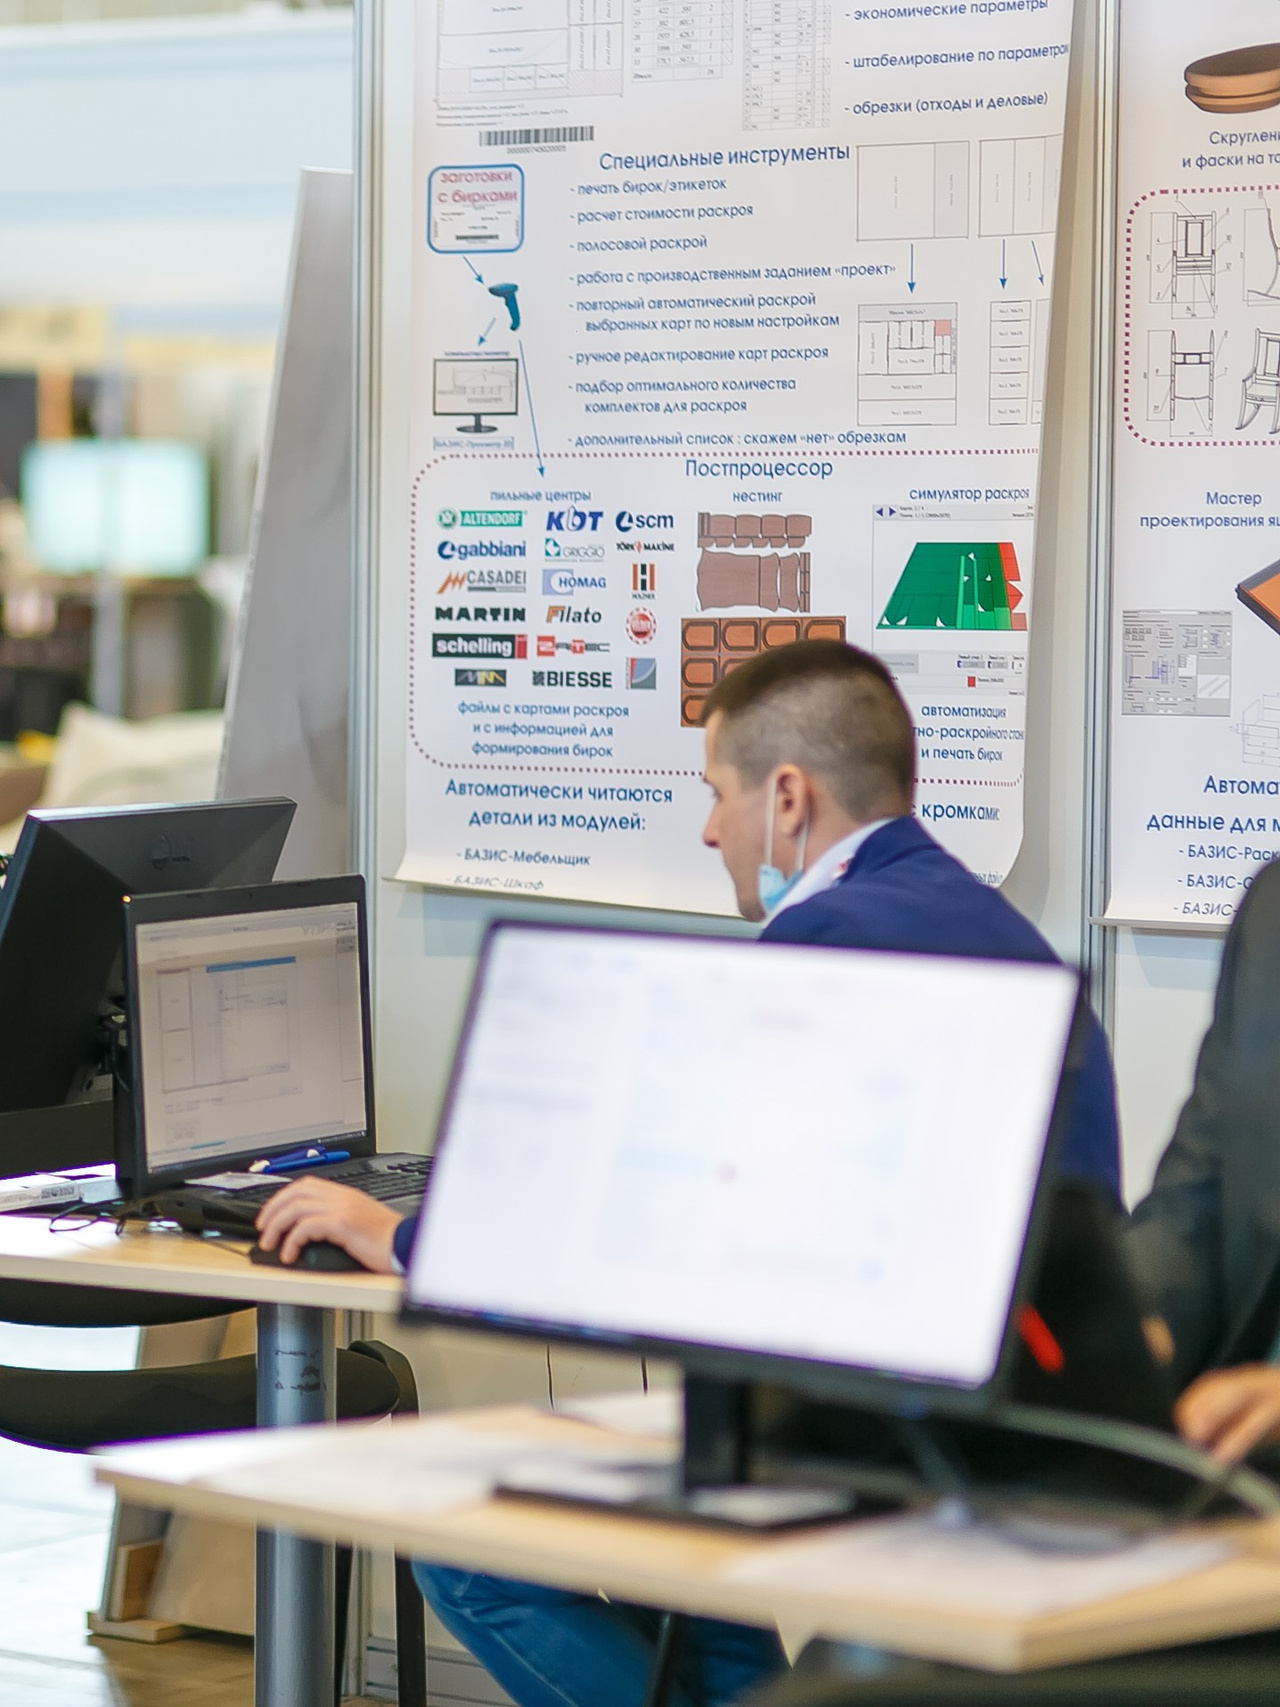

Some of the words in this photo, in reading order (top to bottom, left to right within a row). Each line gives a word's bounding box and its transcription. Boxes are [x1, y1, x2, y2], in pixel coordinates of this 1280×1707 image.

[853, 4, 967, 21] экономические
[853, 50, 975, 69] штабелирование
[978, 51, 995, 63] по
[853, 100, 912, 116] обрезки
[916, 97, 972, 113] (отходы
[975, 97, 984, 109] и
[987, 92, 1049, 111] деловые)
[599, 150, 724, 173] Специальные
[728, 145, 851, 171] инструменты
[1182, 157, 1192, 168] и
[1195, 154, 1244, 171] фаски
[1247, 155, 1264, 165] на
[440, 171, 513, 184] заготовки
[577, 181, 620, 196] печать
[622, 178, 727, 196] бирок/этикеток
[438, 192, 449, 203] с
[451, 189, 518, 204] бирками
[577, 209, 622, 225] расчет
[625, 207, 696, 221] стоимости
[698, 204, 754, 222] раскроя
[577, 236, 648, 252] полосовой
[650, 235, 708, 251] раскрой
[577, 270, 623, 285] работа
[627, 273, 635, 283] с
[637, 268, 761, 285] производственным
[764, 266, 831, 281] заданием
[576, 296, 645, 312] повторный
[648, 294, 755, 310] автоматический
[758, 291, 817, 308] раскрой
[586, 318, 658, 333] выбранных
[660, 318, 692, 332] карт
[694, 318, 710, 329] по
[713, 317, 755, 328] новым
[757, 313, 840, 329] настройкам
[576, 350, 621, 365] ручное
[624, 349, 735, 365] редактирование
[738, 348, 768, 362] карт
[771, 346, 829, 362] раскроя
[575, 380, 624, 395] подбор
[626, 380, 719, 393] оптимального
[722, 378, 796, 391] количества
[585, 401, 661, 414] комплектов
[663, 401, 688, 413] для
[690, 400, 747, 415] раскроя
[575, 431, 684, 447] дополнительный
[686, 434, 734, 447] список
[744, 432, 798, 445] скажем
[837, 430, 907, 447] обрезкам
[685, 458, 834, 480] Постпроцессор
[490, 491, 543, 501] пильные
[546, 490, 592, 504] центры
[732, 490, 784, 503] нестинг
[909, 488, 982, 503] симулятор
[1206, 491, 1263, 508] Мастер
[460, 511, 522, 527] ALTENDORF
[632, 513, 674, 529] scm
[1140, 514, 1264, 530] проектирования
[458, 540, 527, 560] gabbiani
[467, 570, 527, 585] CASADEI
[558, 576, 607, 589] HOMAG
[435, 606, 526, 622] MARTIN
[436, 636, 513, 657] schelling
[546, 670, 613, 688] BIESSE
[458, 701, 501, 716] файлы
[503, 704, 511, 714] с
[514, 704, 570, 717] картами
[573, 706, 630, 719] раскроя
[921, 705, 1007, 720] автоматизация
[473, 724, 481, 734] и
[483, 724, 492, 734] с
[495, 723, 587, 738] информацией
[589, 725, 614, 737] для
[471, 741, 569, 757] формирования
[572, 743, 613, 759] бирок
[921, 748, 930, 759] и
[933, 748, 975, 760] печать
[977, 747, 1003, 763] бирок
[445, 778, 583, 800] Автоматически
[588, 786, 673, 803] читаются
[1203, 775, 1280, 796] Автома
[468, 810, 533, 827] детали
[537, 812, 557, 826] из
[561, 812, 646, 833] модулей:
[1147, 814, 1225, 831] данные
[1230, 817, 1266, 834] для
[464, 848, 590, 867] БАЗИС-Мебельщик
